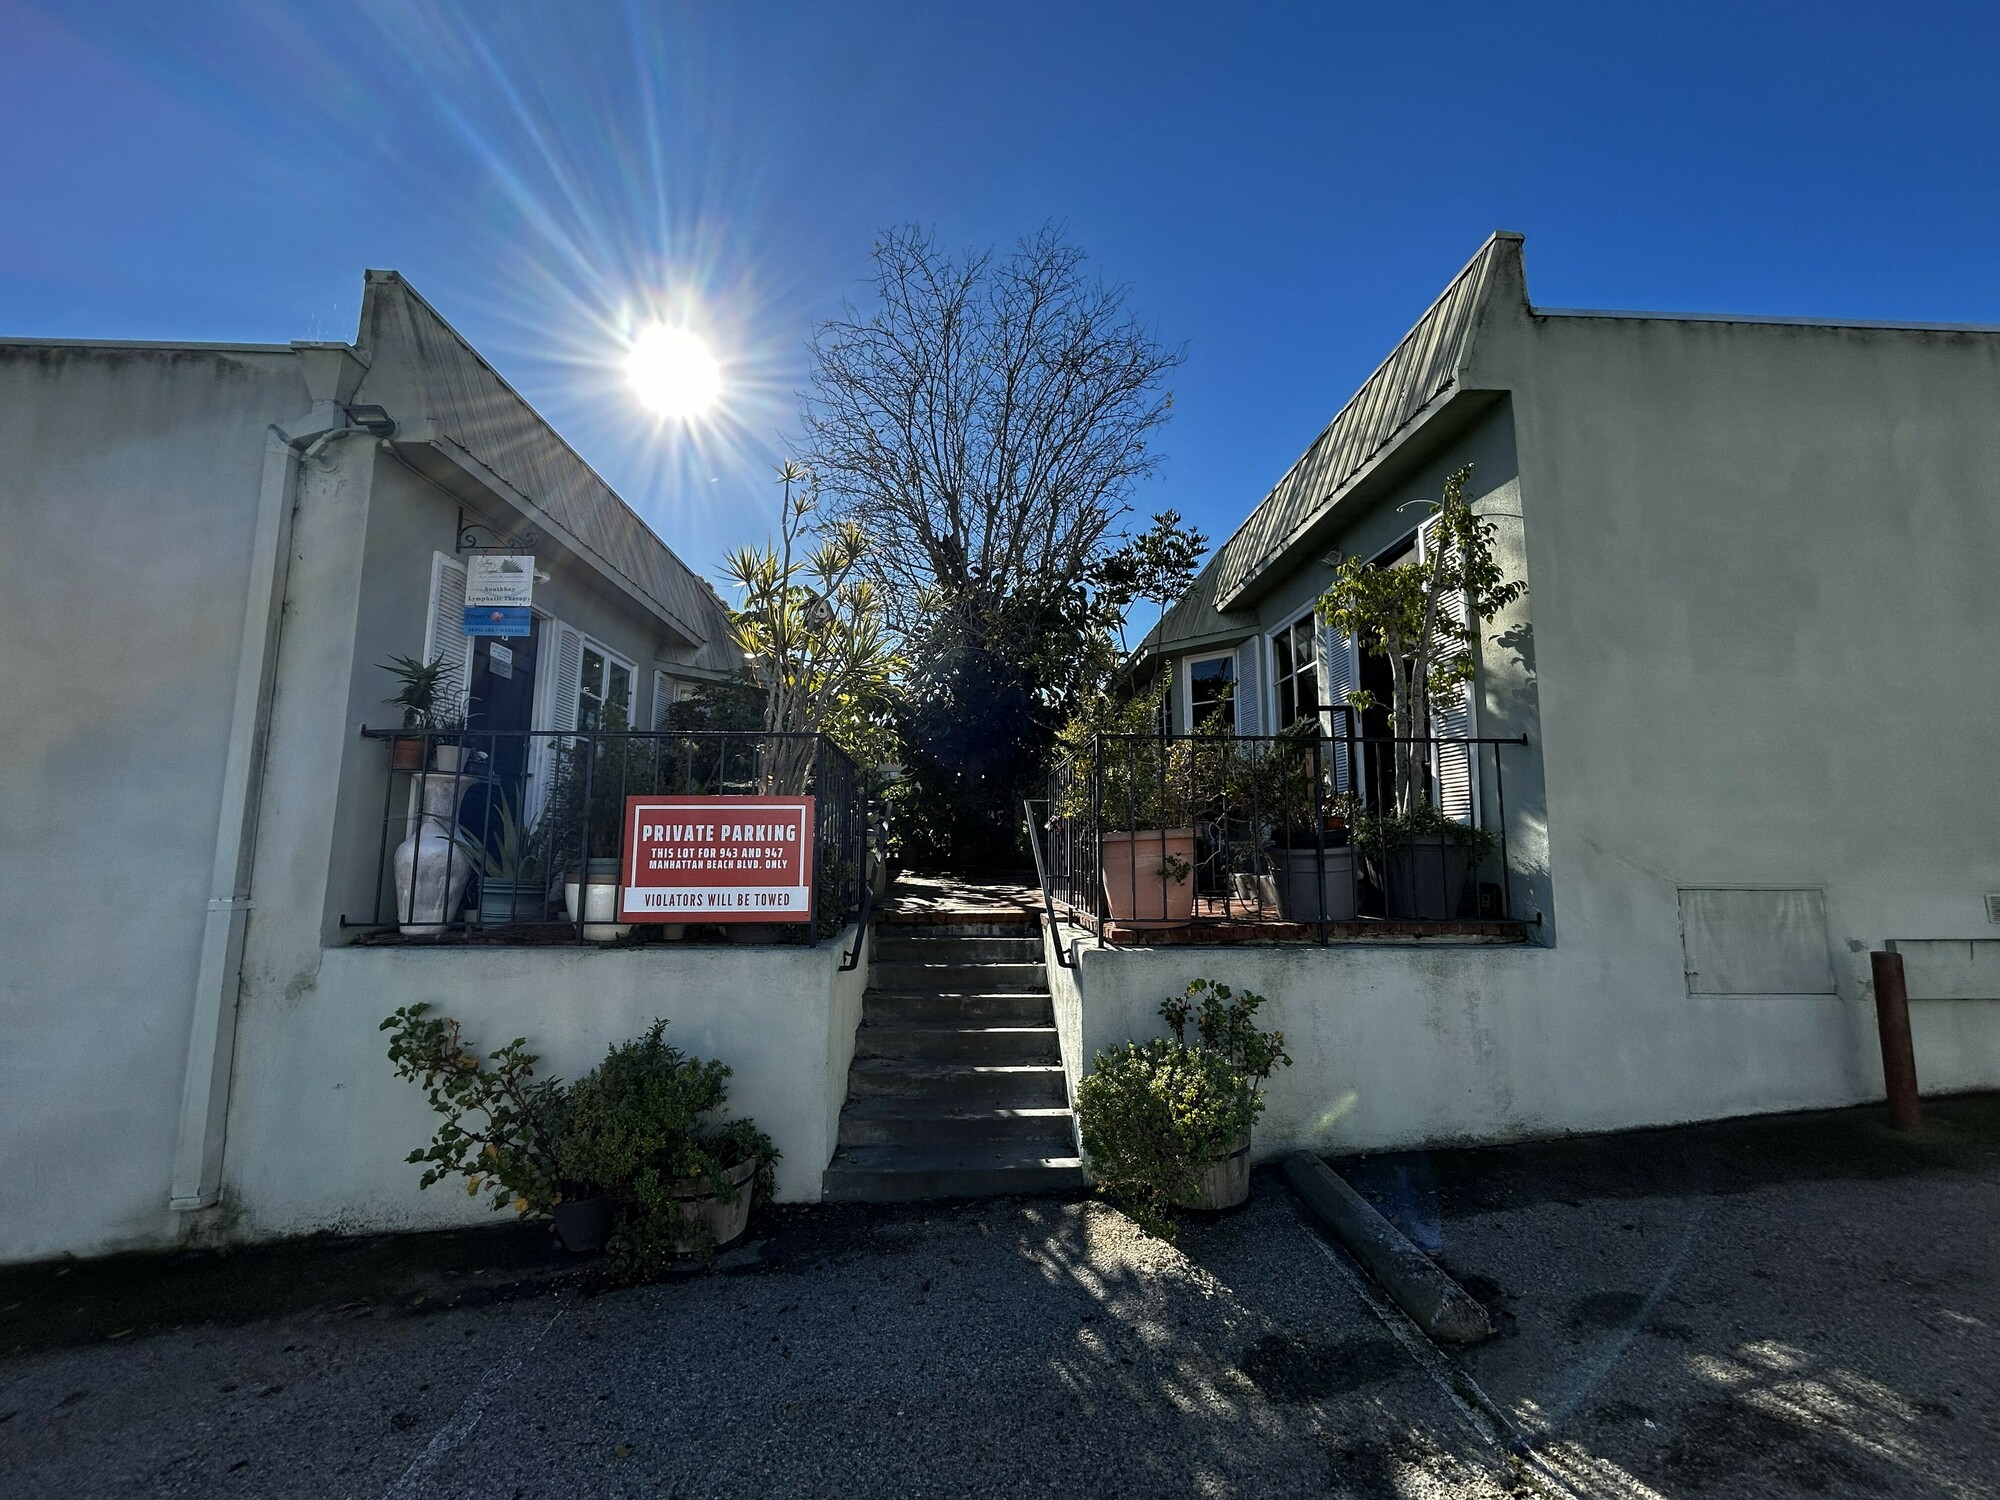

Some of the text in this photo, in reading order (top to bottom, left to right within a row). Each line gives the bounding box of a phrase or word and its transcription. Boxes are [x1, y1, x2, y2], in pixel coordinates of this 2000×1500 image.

[642, 824, 796, 842] PRIVATE PARKING
[651, 847, 783, 858] THIS LOT FOR 943 AND 947
[649, 859, 788, 869] MANHATTAN BEACH BLVD. ONLY
[644, 893, 790, 907] VIOLATORS WILL BE TOWED
